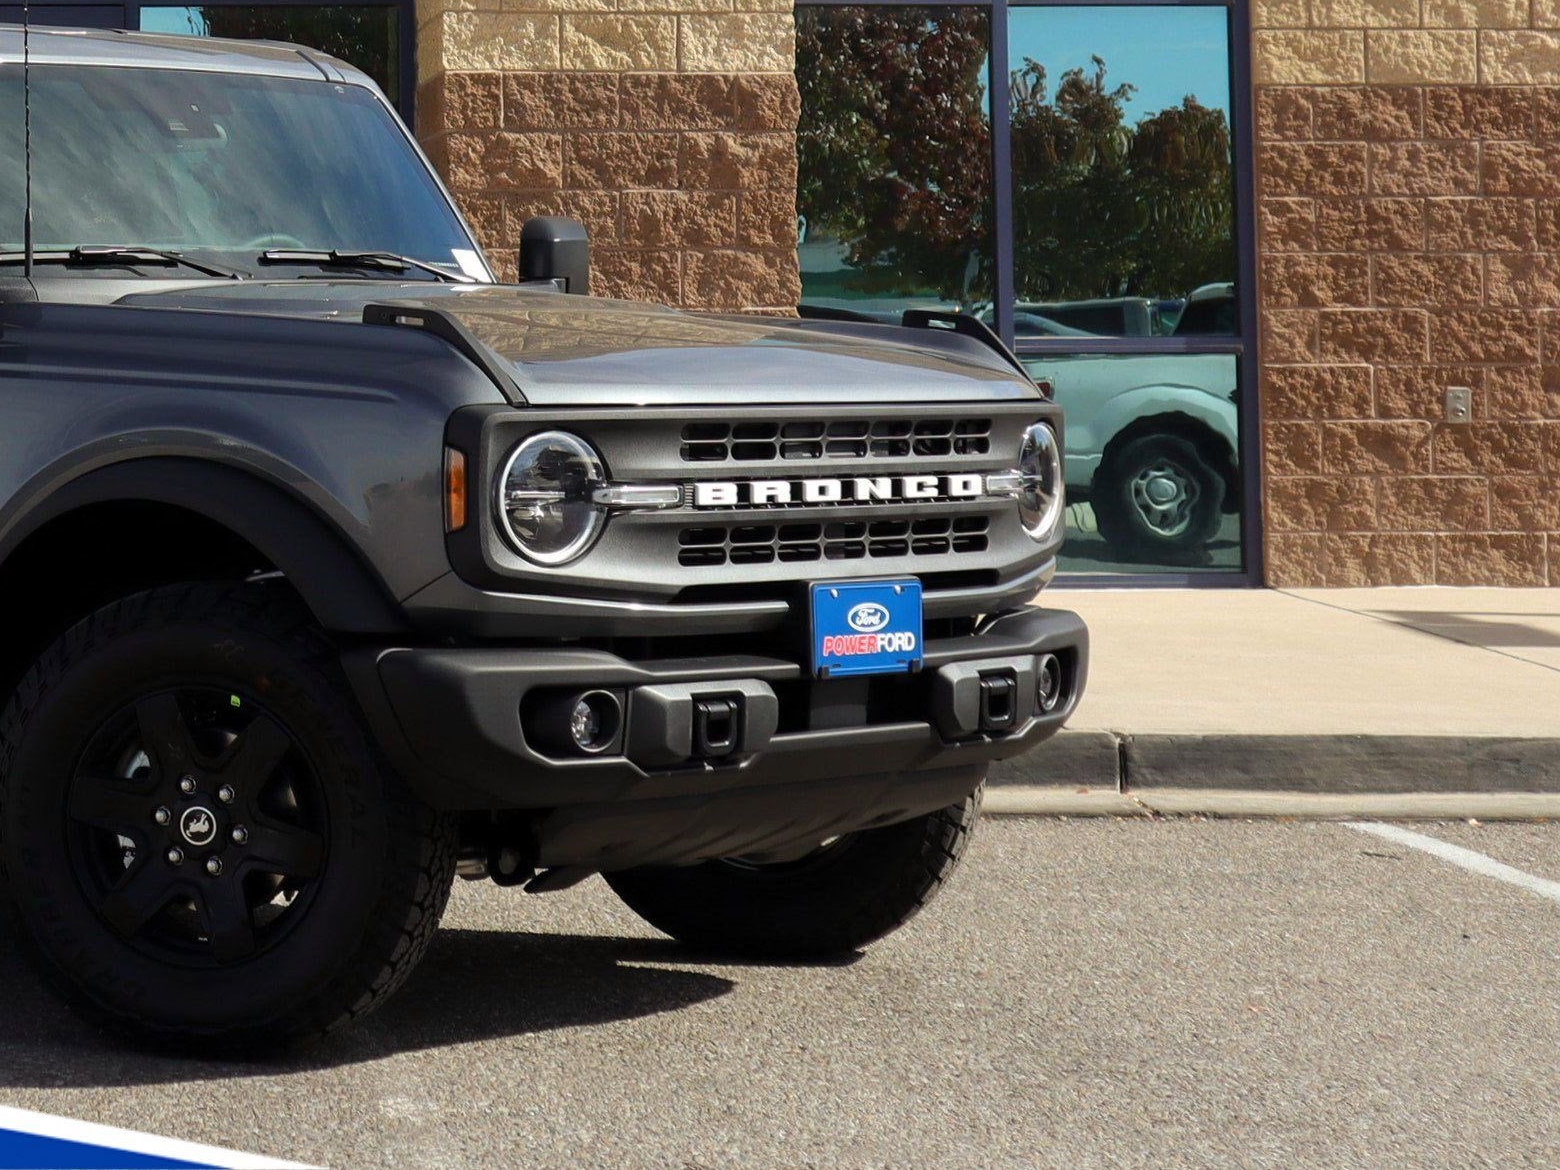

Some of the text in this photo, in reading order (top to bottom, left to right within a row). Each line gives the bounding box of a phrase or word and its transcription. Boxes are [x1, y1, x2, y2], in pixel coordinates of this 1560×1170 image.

[693, 473, 983, 506] BRONCO
[855, 608, 881, 626] Ford
[823, 632, 916, 657] POWERFORD
